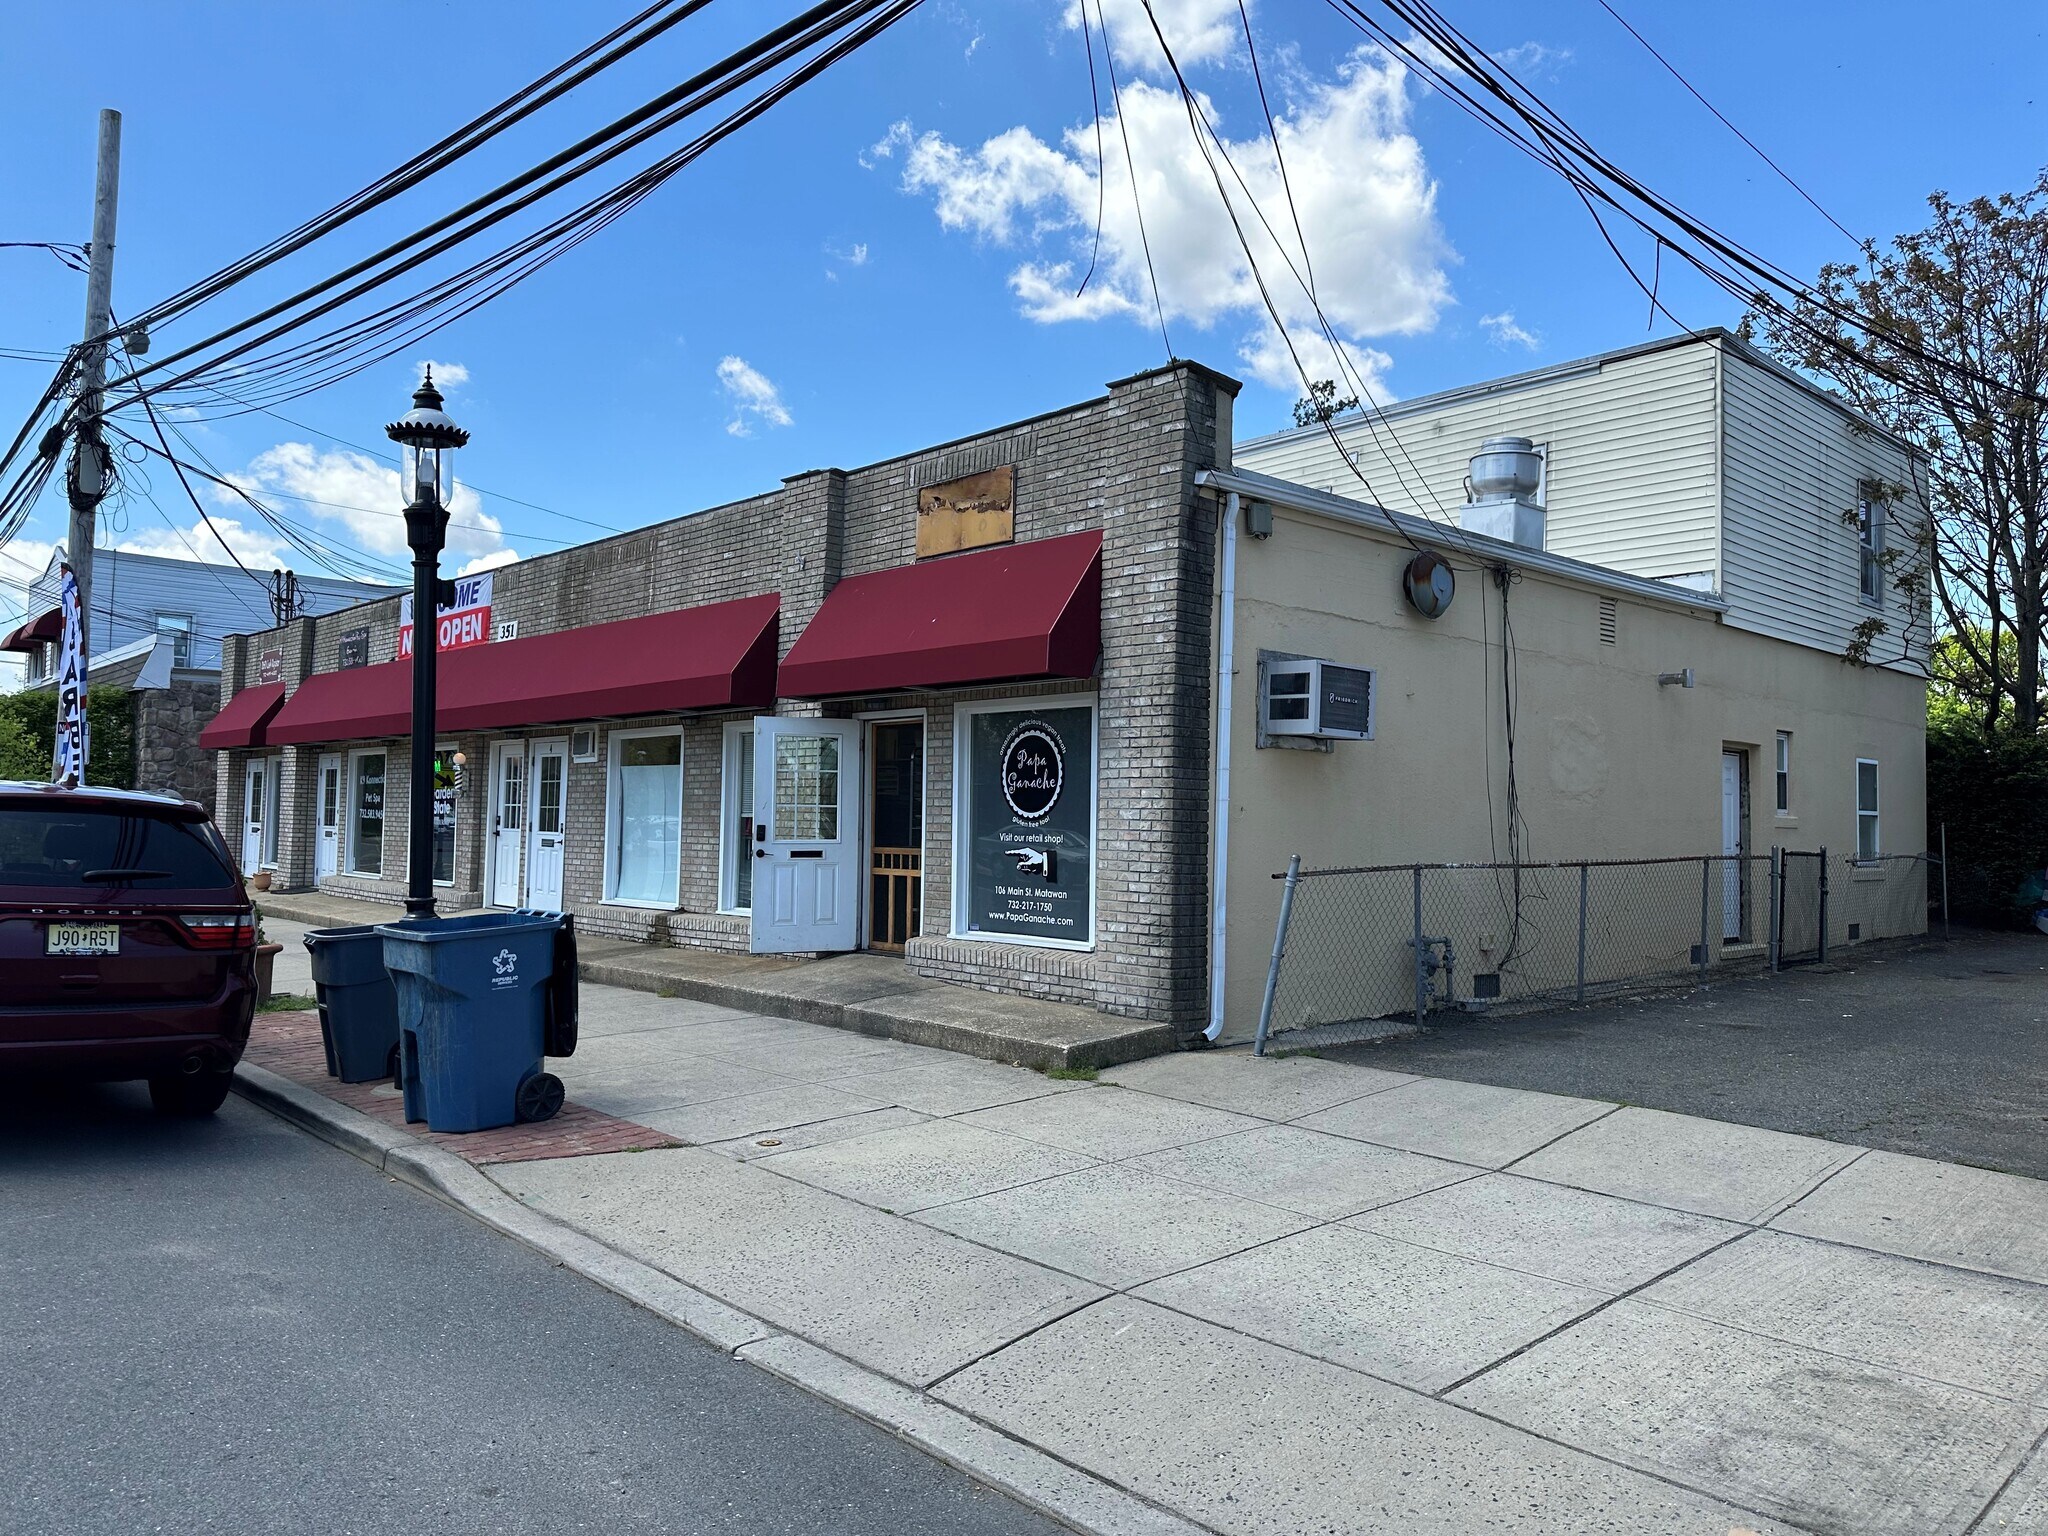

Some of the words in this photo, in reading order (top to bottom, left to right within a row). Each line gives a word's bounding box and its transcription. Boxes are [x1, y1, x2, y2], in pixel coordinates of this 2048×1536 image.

[440, 612, 482, 647] OPEN
[500, 623, 515, 639] 351
[1000, 727, 1019, 756] amazingly
[1018, 719, 1042, 729] delicious
[1042, 720, 1058, 737] vegan
[1056, 732, 1067, 754] treats
[1017, 749, 1047, 775] Papa
[1007, 768, 1057, 794] Ganache
[365, 792, 373, 803] Pet
[373, 792, 381, 804] Spa
[434, 800, 451, 815] State
[1012, 816, 1028, 828] gluten
[1000, 833, 1013, 842] Visit
[1013, 834, 1025, 842] our
[1026, 833, 1043, 843] retail
[1044, 834, 1064, 845] shop!
[995, 885, 1006, 895] 106
[1007, 886, 1024, 897] Main
[1025, 887, 1033, 897] St.
[1034, 888, 1068, 899] Matawan
[31, 908, 143, 916] DODGE
[1007, 900, 1053, 912] 732-217-1750
[988, 911, 1074, 926] www.PapaGanache.com
[52, 930, 80, 946] J90
[89, 930, 117, 946] RST
